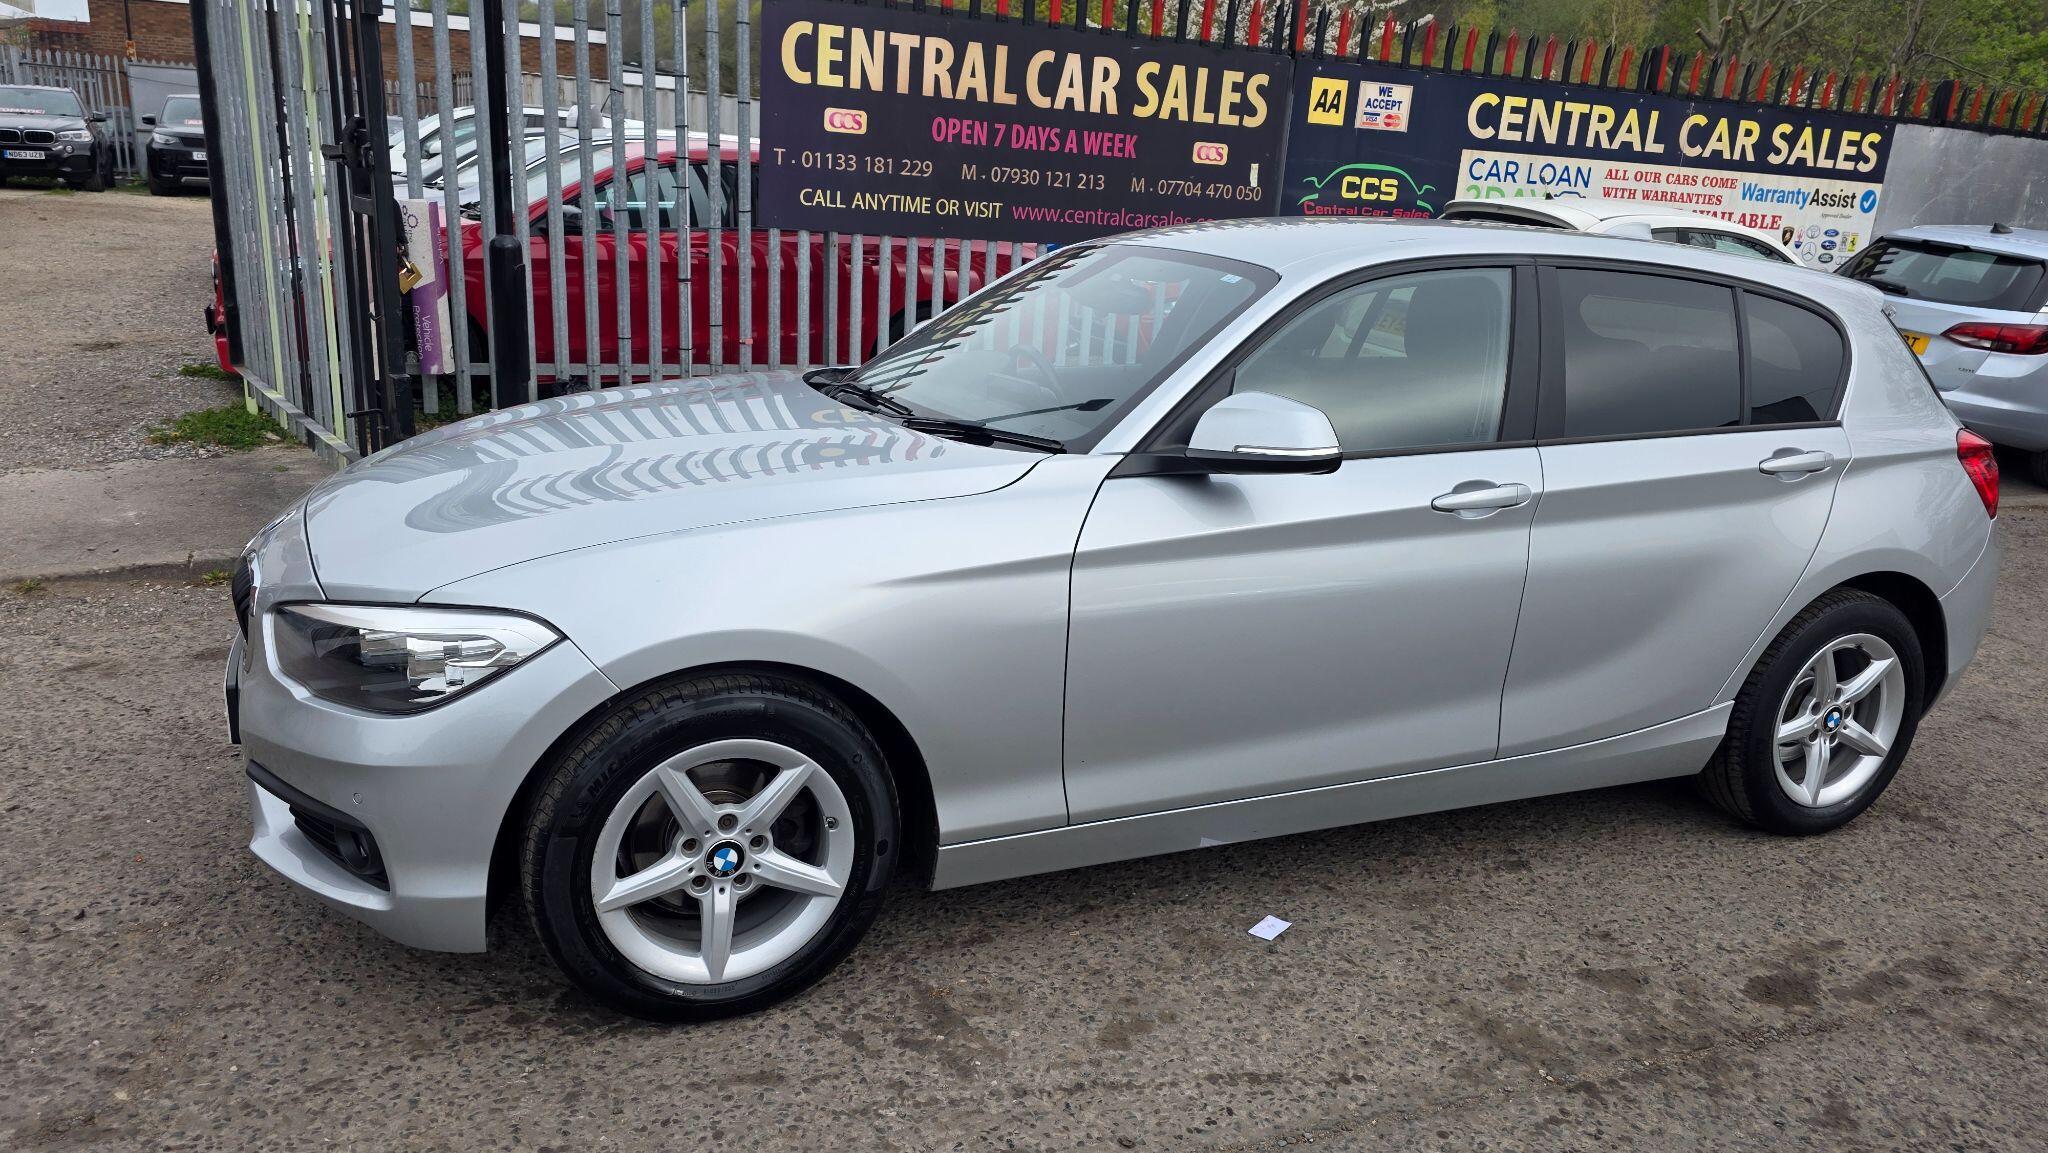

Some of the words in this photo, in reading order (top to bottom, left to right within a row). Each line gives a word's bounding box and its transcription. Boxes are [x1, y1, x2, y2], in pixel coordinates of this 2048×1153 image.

[781, 20, 1017, 105] CENTRAL
[1025, 50, 1121, 115] CAR
[1132, 61, 1270, 128] SALES
[1313, 88, 1342, 114] AA
[1365, 98, 1403, 112] ACCEPT
[1378, 86, 1394, 98] WE
[932, 116, 988, 146] OPEN
[994, 123, 1006, 147] 7
[1011, 124, 1061, 152] DAYS
[1064, 129, 1078, 154] A
[1083, 131, 1138, 159] WEEK
[1467, 92, 1665, 154] CENTRAL
[1678, 114, 1760, 162] CAR
[1766, 122, 1882, 173] SALES
[801, 150, 857, 171] 01133
[864, 156, 893, 174] 181
[900, 159, 933, 177] 229
[1468, 157, 1520, 183] CAR
[1526, 162, 1592, 189] LOAN
[991, 166, 1040, 185] 07930
[1045, 171, 1071, 188] 121
[1077, 173, 1105, 190] 213
[1158, 179, 1202, 197] 07704
[1205, 184, 1232, 199] 470
[1236, 185, 1262, 201] 050
[1341, 175, 1399, 202] CCS
[1604, 168, 1630, 181] ALL
[1633, 170, 1662, 184] OUR
[1665, 172, 1699, 187] CARS
[1701, 175, 1739, 190] COME
[799, 188, 847, 208] CALL
[851, 191, 931, 214] ANYTIME
[935, 198, 960, 216] OR
[964, 200, 1003, 219] VISIT
[1602, 186, 1637, 200] WITH
[1641, 189, 1724, 206] WARRANTIES
[1303, 200, 1358, 215] Central
[1361, 207, 1389, 217] Car
[1392, 208, 1431, 219] Sales
[1692, 209, 1782, 230] AILABLE
[412, 305, 424, 360] Protection
[422, 315, 434, 352] Vehicle
